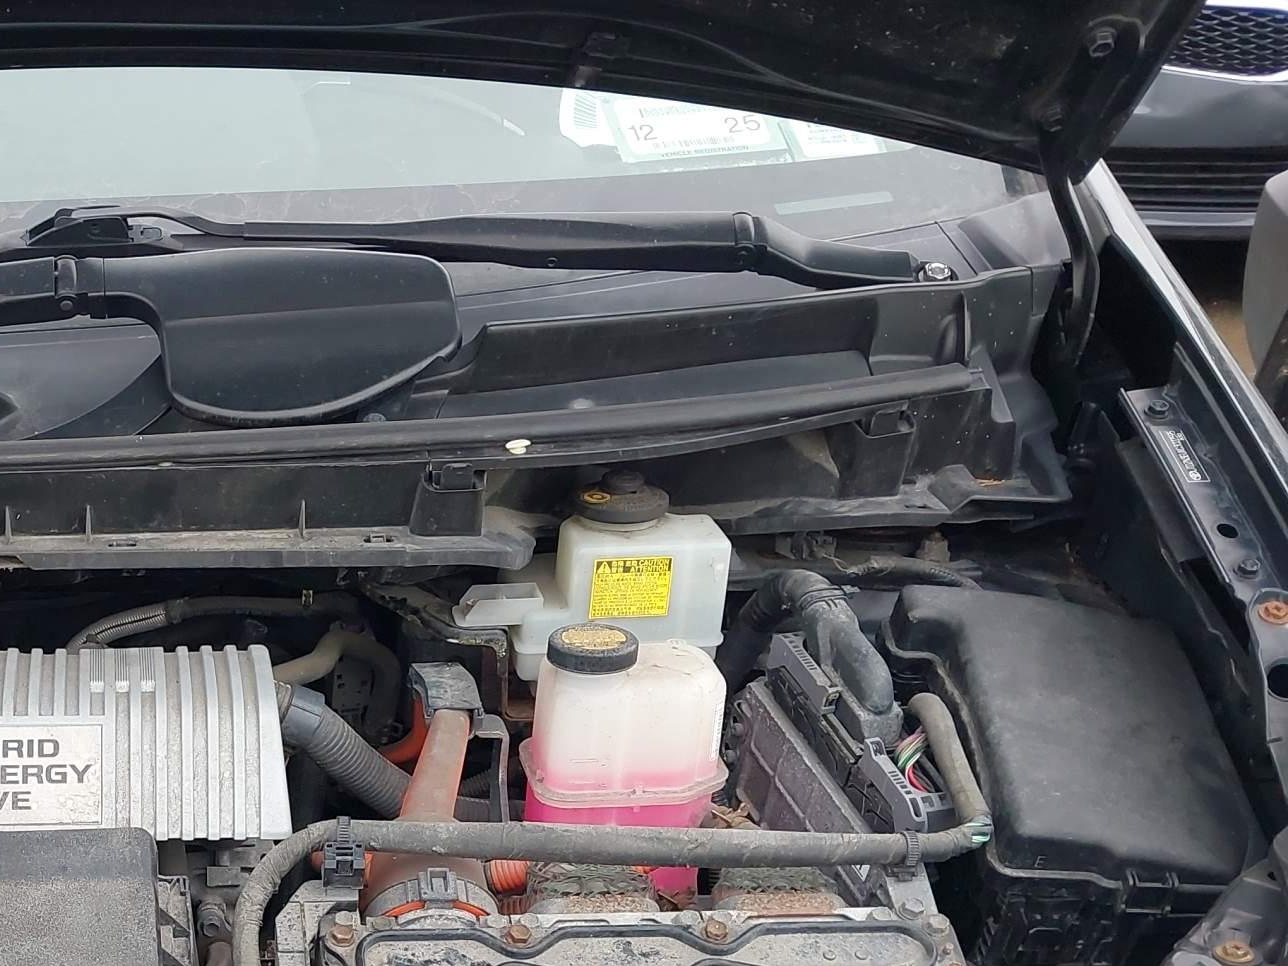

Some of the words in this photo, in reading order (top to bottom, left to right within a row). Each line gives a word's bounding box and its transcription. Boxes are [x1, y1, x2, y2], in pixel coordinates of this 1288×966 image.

[628, 124, 657, 141] 12
[724, 115, 761, 134] 25
[638, 559, 670, 567] CAUTION
